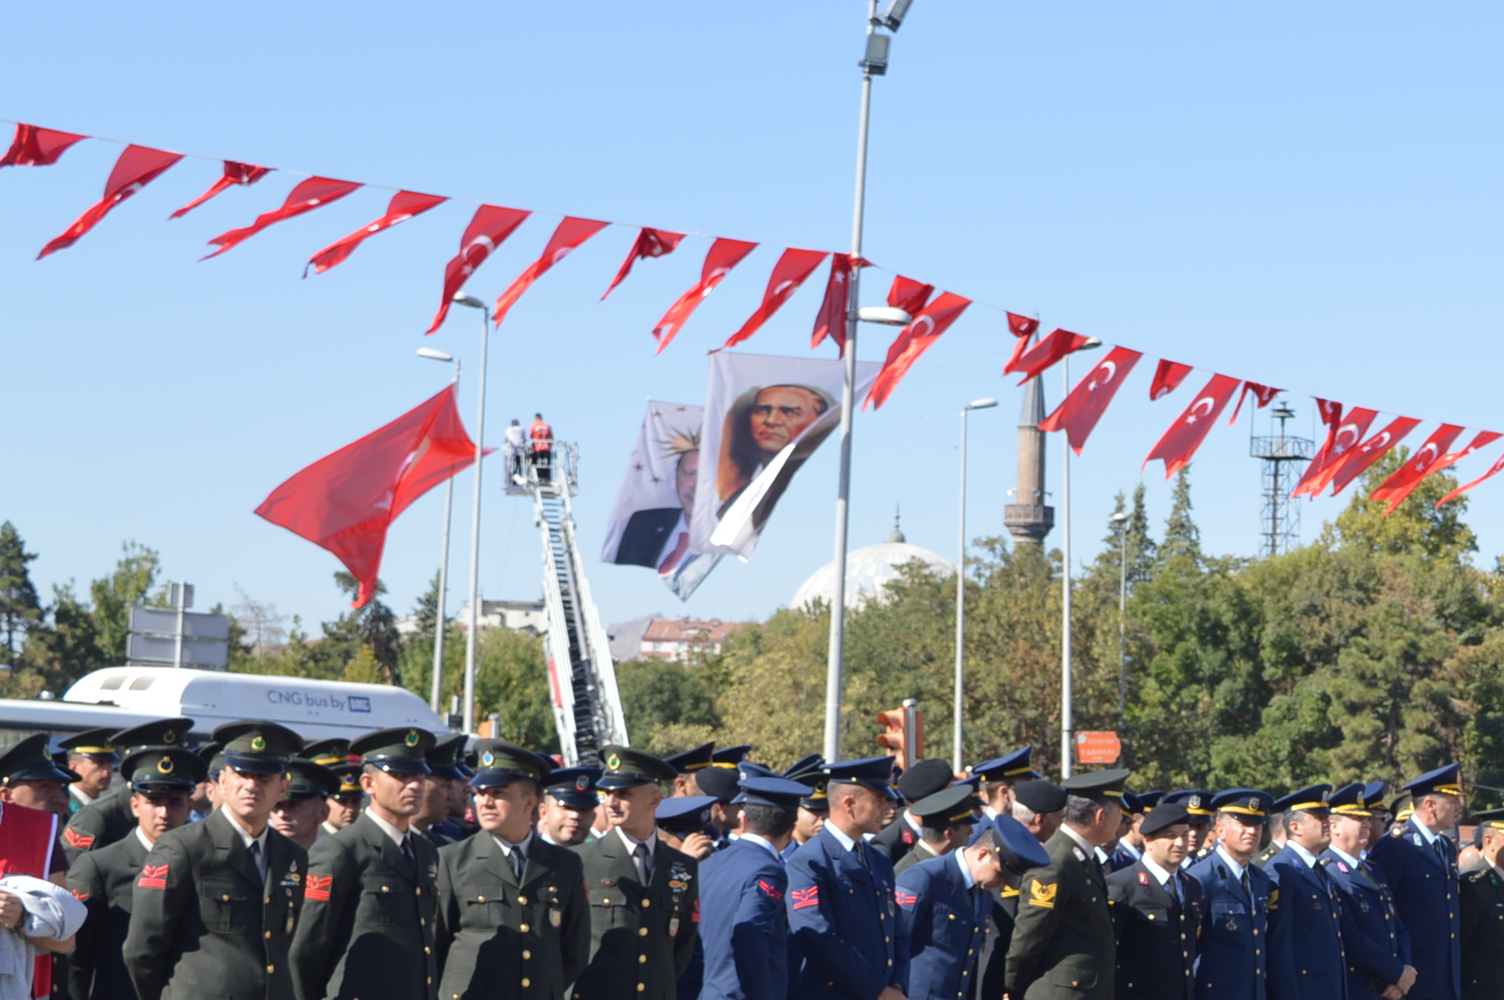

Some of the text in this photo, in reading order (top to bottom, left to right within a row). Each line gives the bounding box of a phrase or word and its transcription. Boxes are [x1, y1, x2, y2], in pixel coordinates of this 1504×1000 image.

[267, 690, 303, 705] CNG
[305, 693, 329, 708] bus
[329, 694, 346, 712] by
